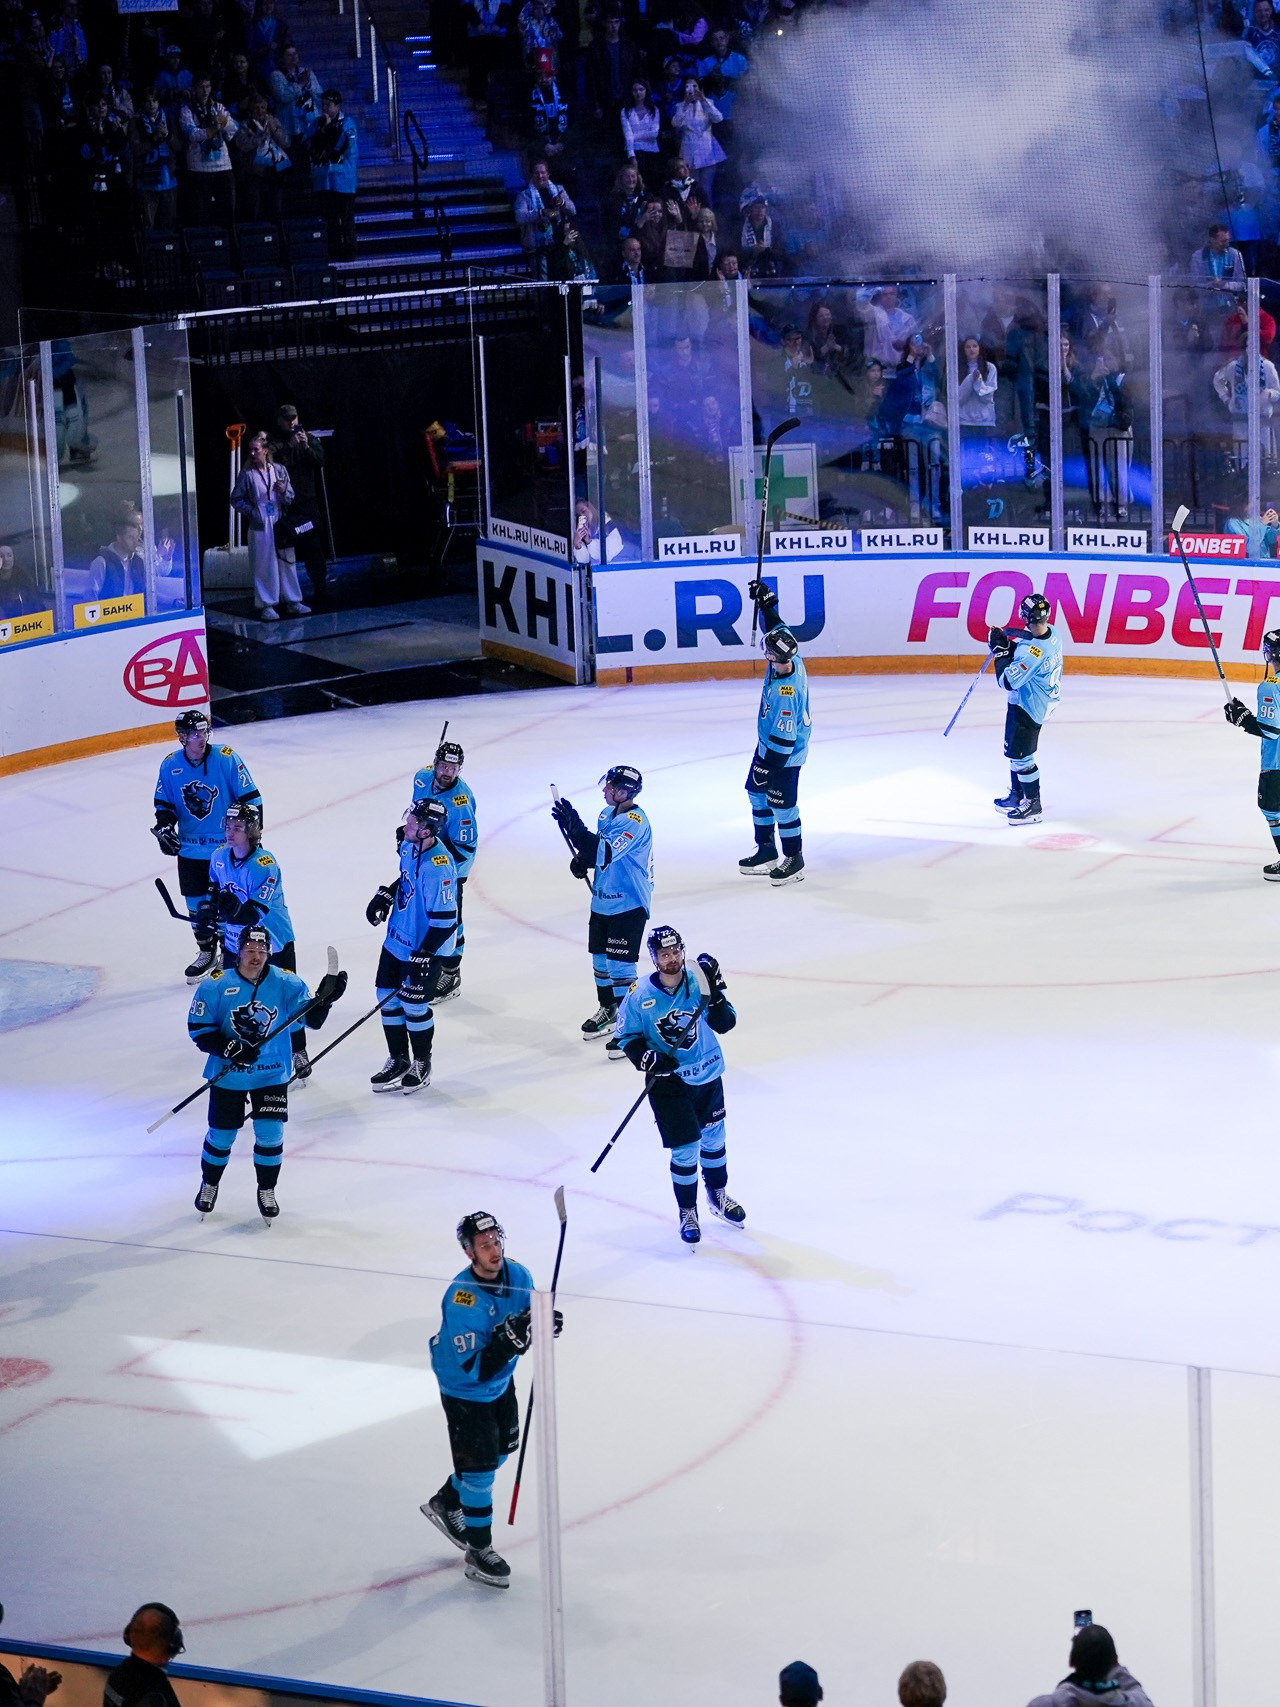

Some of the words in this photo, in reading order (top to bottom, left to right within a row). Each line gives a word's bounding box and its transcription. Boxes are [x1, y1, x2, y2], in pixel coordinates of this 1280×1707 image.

[491, 523, 529, 543] KHL.RU
[866, 533, 939, 547] KHL.RU
[973, 532, 1045, 547] KHL.RU
[1071, 532, 1142, 549] KHL.RU
[533, 534, 567, 555] KHL.RU
[663, 539, 737, 556] KHL.RU
[775, 536, 848, 549] KHL.RU
[1171, 536, 1245, 555] FONBET
[102, 602, 133, 617] БАНК
[13, 620, 43, 635] БАНК
[1260, 705, 1275, 719] 96
[776, 718, 793, 733] 40
[459, 828, 474, 843] 61
[441, 889, 454, 906] 14
[607, 938, 629, 946] Belavia
[190, 999, 206, 1017] 93
[256, 1061, 283, 1072] Bank
[453, 1332, 477, 1353] 97
